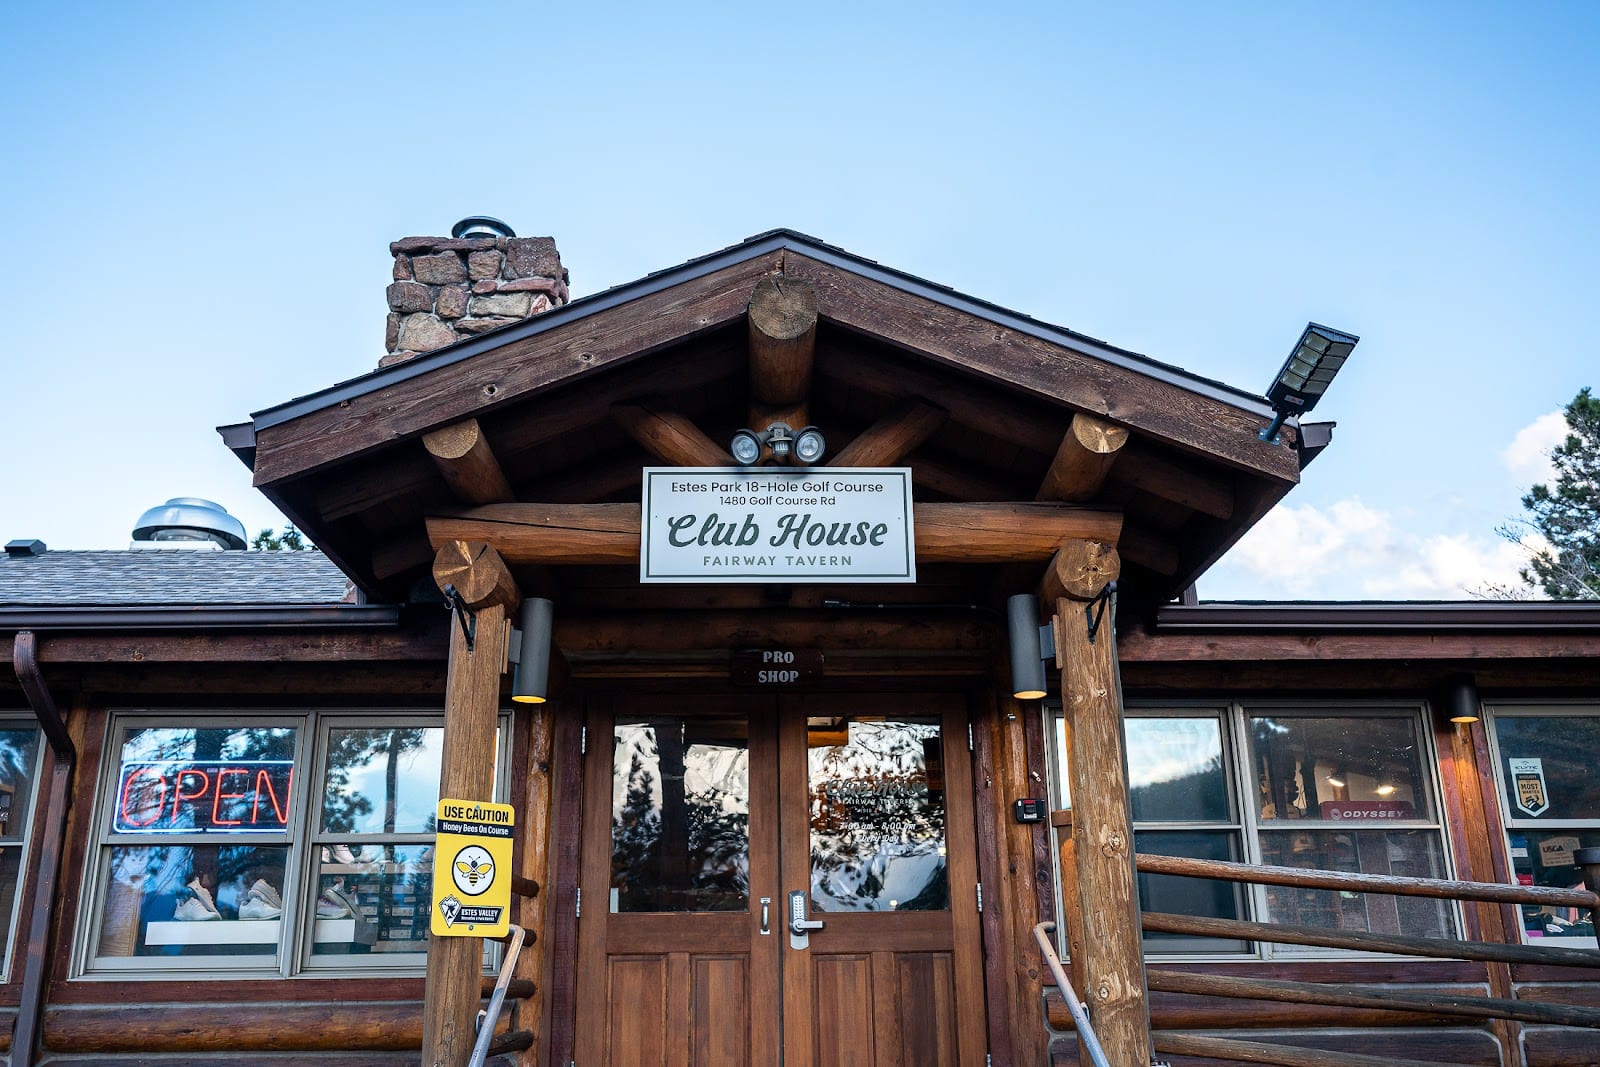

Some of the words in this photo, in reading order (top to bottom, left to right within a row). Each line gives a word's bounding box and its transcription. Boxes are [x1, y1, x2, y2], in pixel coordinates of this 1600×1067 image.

[671, 481, 707, 493] Estes
[711, 481, 742, 493] Park
[745, 481, 798, 493] 18-Hole
[802, 481, 830, 493] Golf
[833, 481, 884, 493] Course
[720, 496, 746, 506] 1480
[749, 496, 773, 506] Golf
[775, 496, 818, 506] Course
[820, 496, 836, 506] Rd
[667, 513, 760, 548] Club
[769, 513, 888, 550] House
[703, 555, 777, 566] FAIRWAY
[785, 555, 852, 566] TAVERN
[762, 651, 795, 664] PRO
[758, 670, 799, 683] SHOP
[121, 767, 293, 827] OPEN
[444, 805, 464, 819] USE
[466, 807, 509, 823] CAUTION
[1343, 810, 1404, 818] ODYSSEY
[443, 822, 462, 833] Honey
[463, 824, 478, 833] Bees
[479, 825, 488, 834] On
[488, 826, 509, 836] Course
[881, 822, 901, 830] 8:00
[1543, 845, 1564, 853] USGA
[461, 908, 478, 916] ESTES
[478, 909, 498, 917] VALLEY
